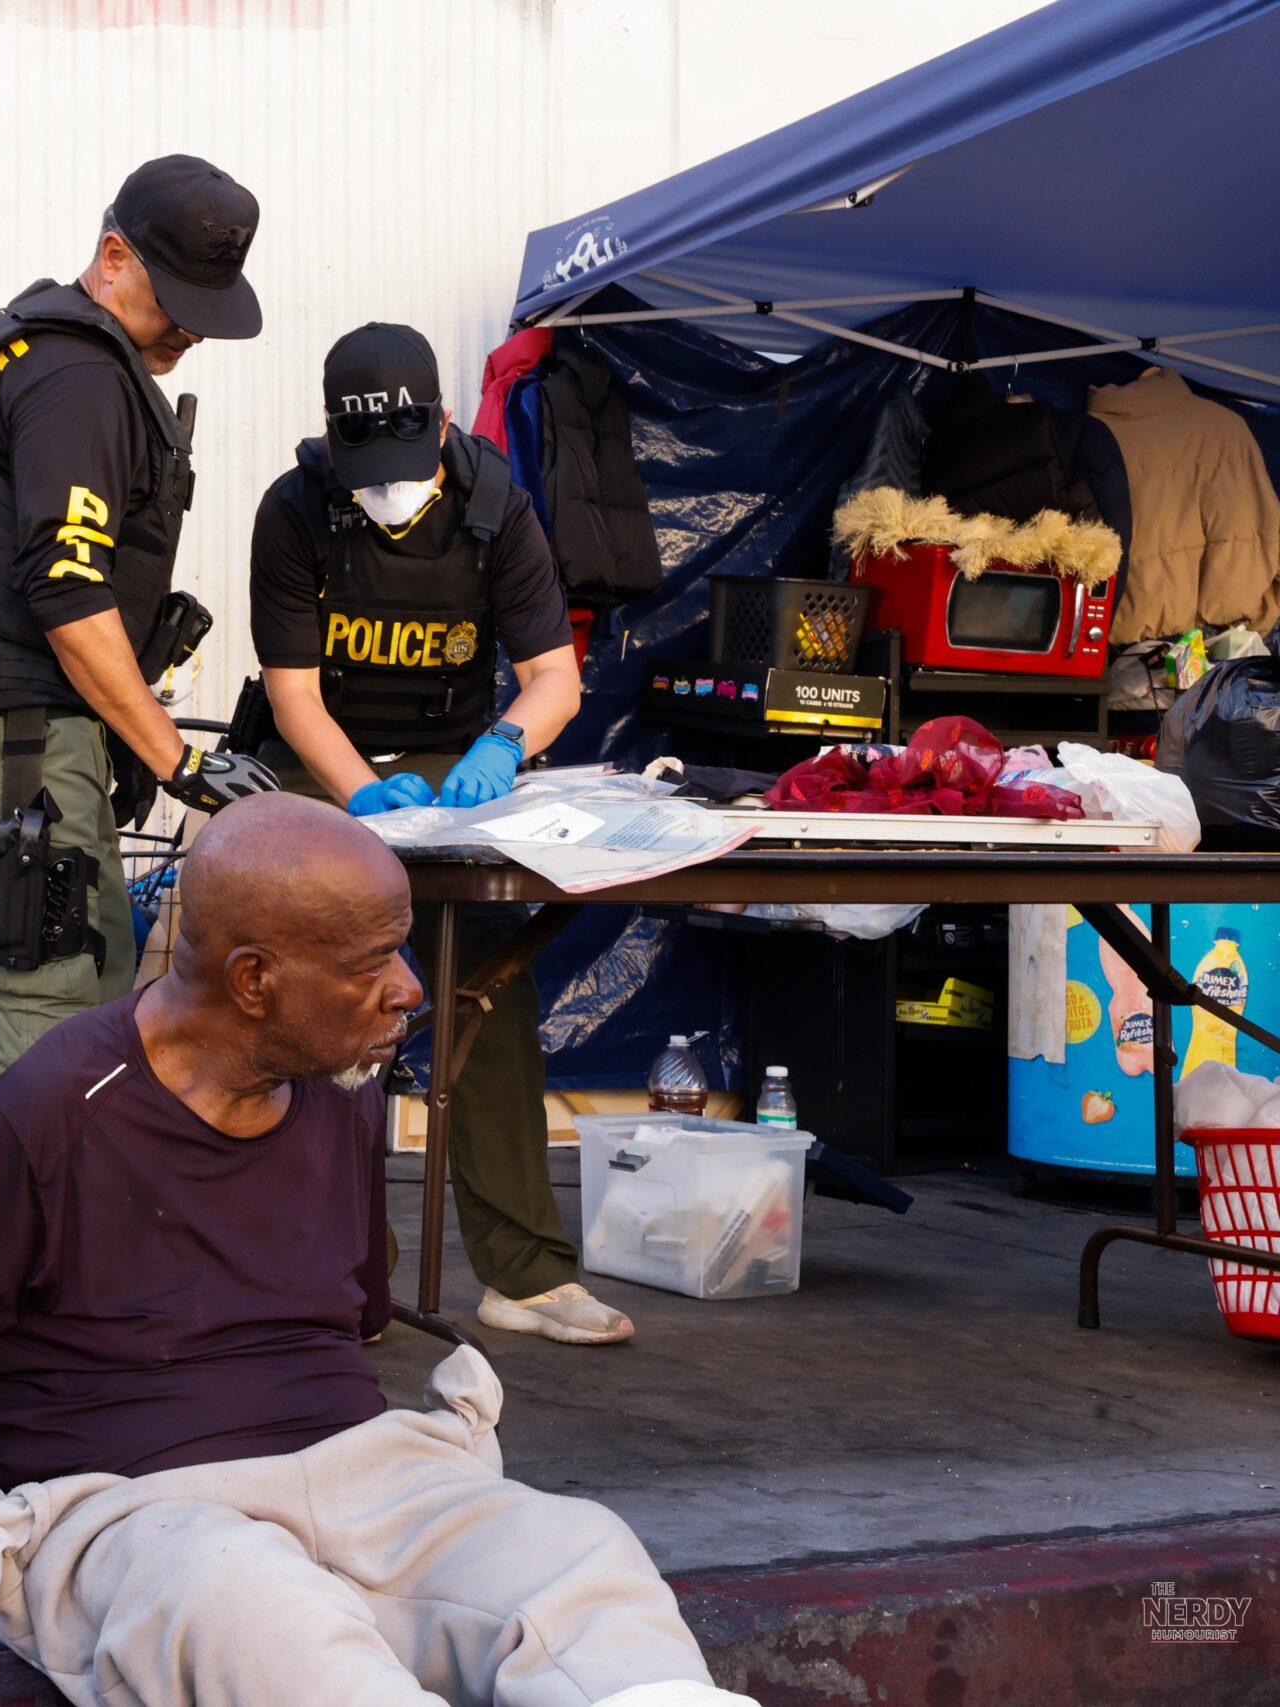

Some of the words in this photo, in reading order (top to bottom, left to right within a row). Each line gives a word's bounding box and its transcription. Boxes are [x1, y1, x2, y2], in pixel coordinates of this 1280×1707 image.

[325, 612, 448, 667] POLICE
[795, 685, 819, 699] 100
[821, 687, 861, 703] UNITS
[1200, 973, 1237, 987] JUMEX
[1123, 1018, 1152, 1029] JUMEX
